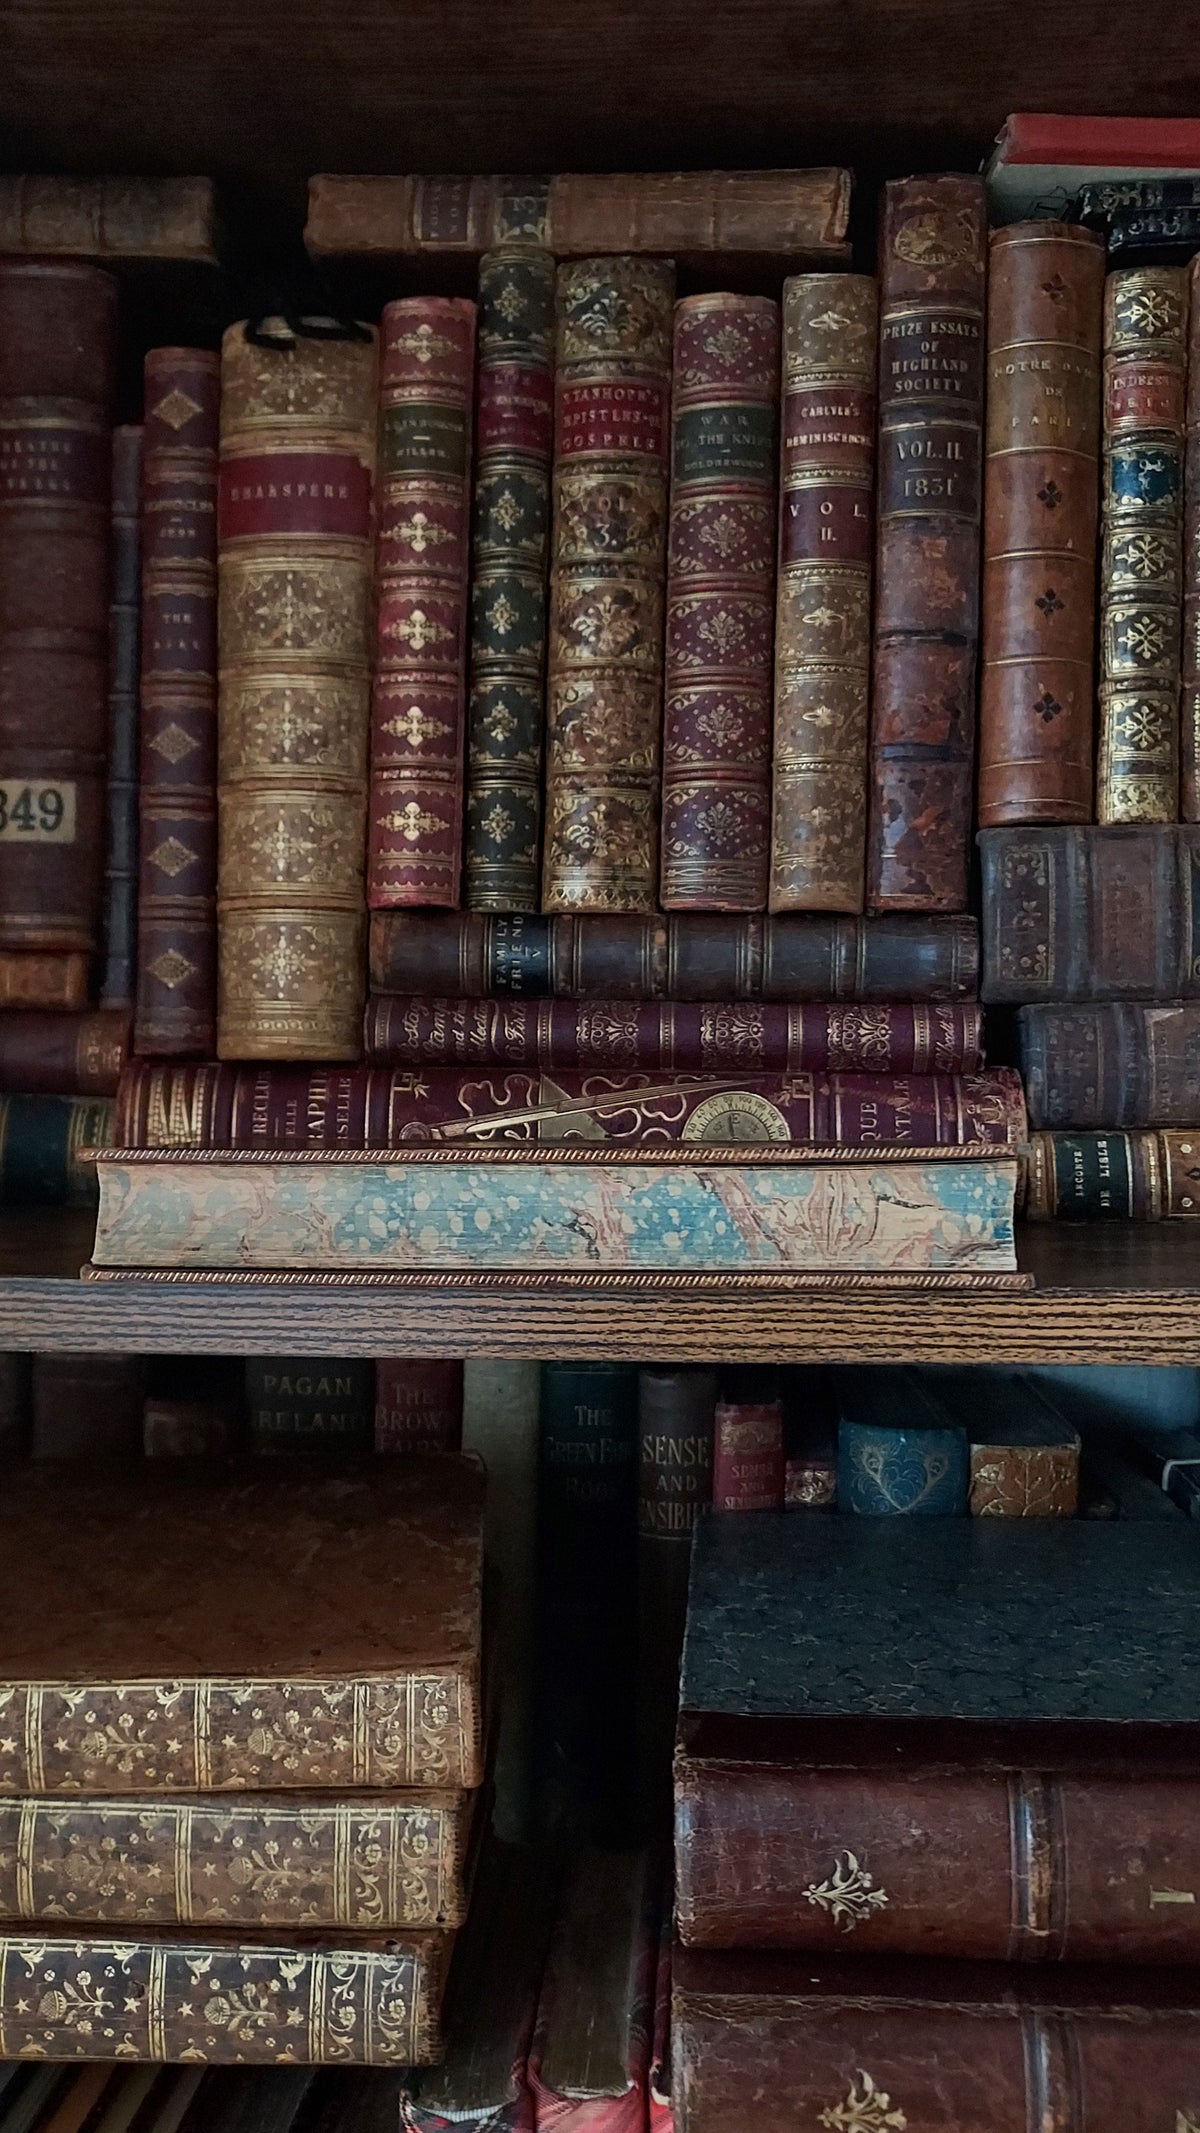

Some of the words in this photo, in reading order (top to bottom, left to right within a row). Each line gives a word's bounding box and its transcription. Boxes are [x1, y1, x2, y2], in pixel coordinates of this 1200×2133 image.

[883, 322, 923, 340] PRIZE
[931, 321, 979, 338] ESSAYS
[920, 341, 940, 353] OF
[891, 358, 968, 374] HIGHLAND
[895, 377, 961, 393] SOCIETY
[700, 415, 748, 426] WAR
[698, 433, 724, 446] THE
[496, 919, 508, 984] FAMILY
[511, 916, 525, 990] FRIEND
[264, 1375, 352, 1396] PAGAN
[642, 1433, 710, 1468] SENSE
[656, 1474, 698, 1492] AND
